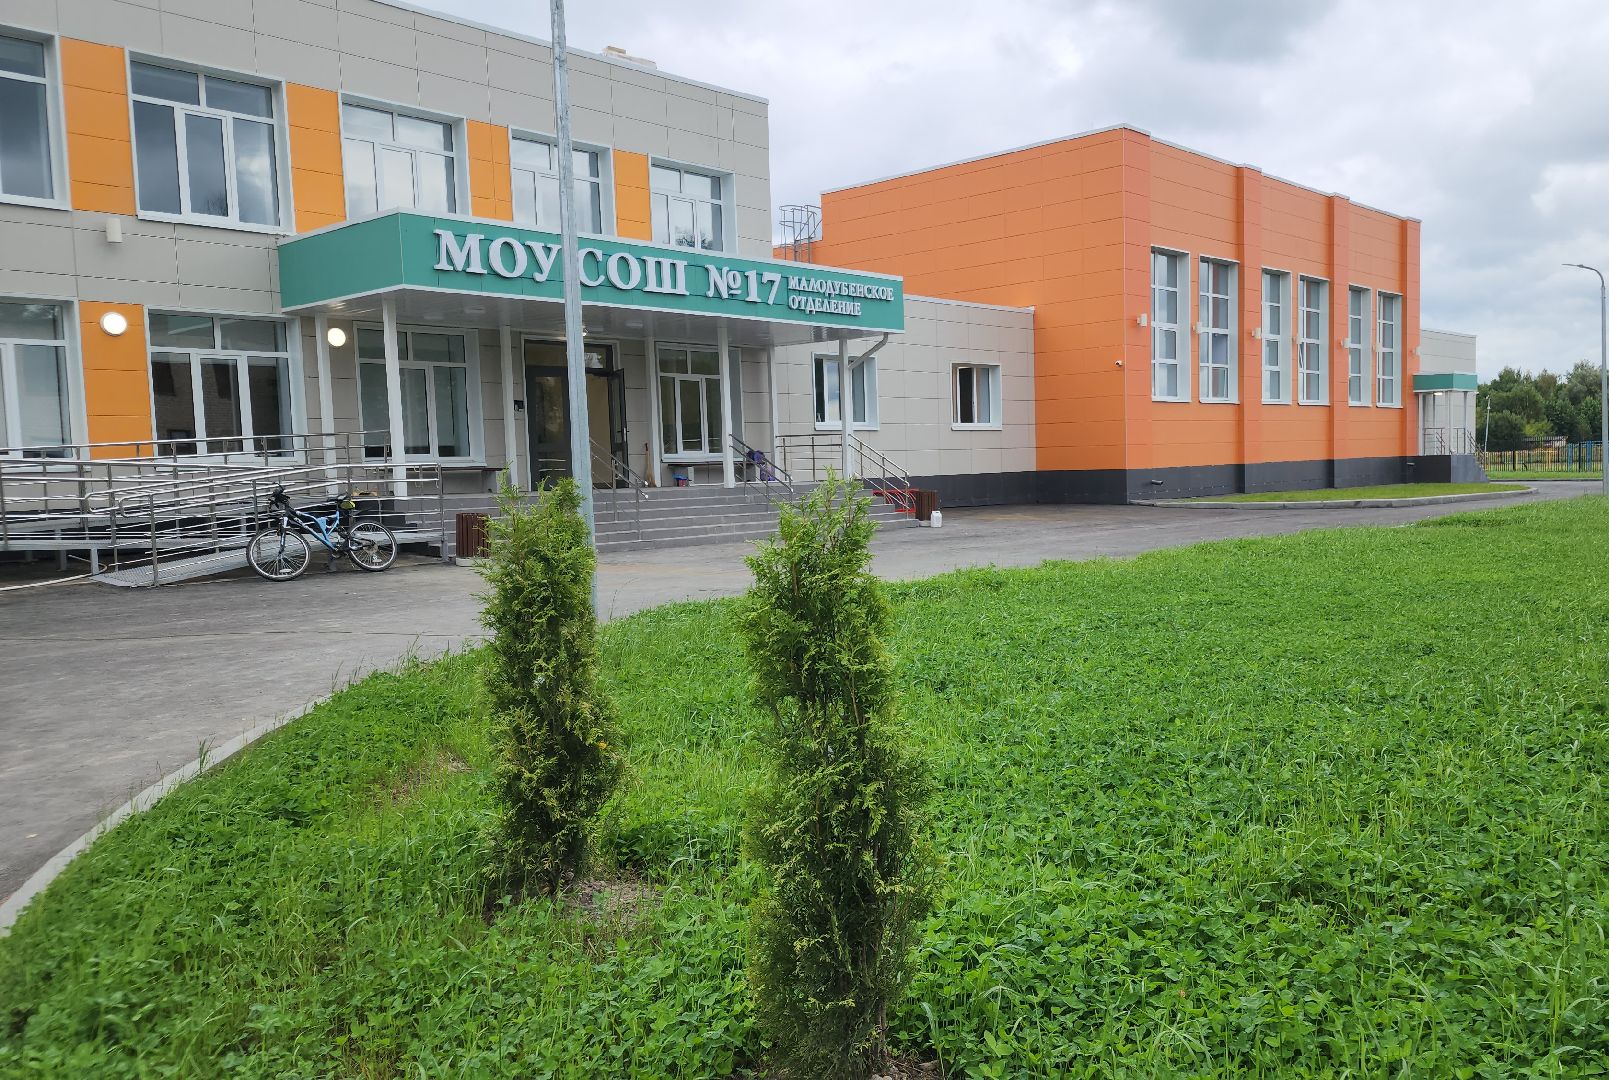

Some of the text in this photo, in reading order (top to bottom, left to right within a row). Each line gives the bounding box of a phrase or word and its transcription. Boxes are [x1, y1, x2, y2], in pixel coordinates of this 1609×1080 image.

[433, 229, 782, 305] МОУ СОШ №17
[788, 275, 894, 301] МАЛОДУБЕНСКОЕ
[789, 295, 862, 316] ОТДЕЛЕНИЕ
